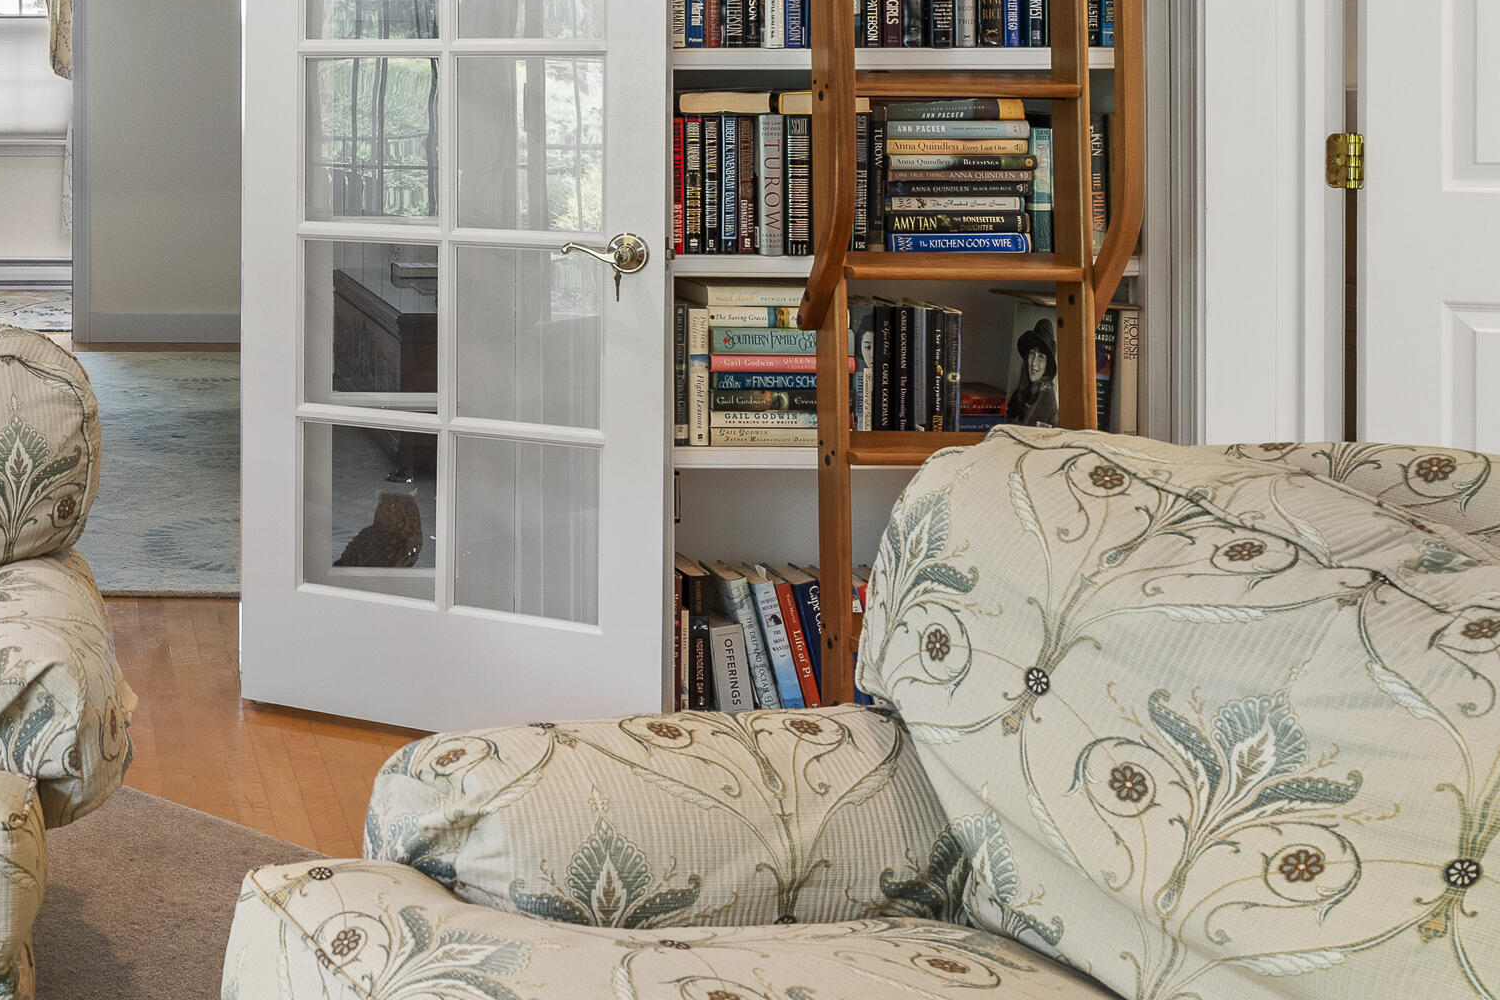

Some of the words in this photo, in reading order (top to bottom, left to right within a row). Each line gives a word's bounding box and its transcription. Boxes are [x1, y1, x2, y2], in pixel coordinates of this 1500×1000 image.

[691, 2, 703, 26] Martini
[886, 0, 899, 24] GIRLS
[764, 139, 780, 230] TUROW
[894, 217, 916, 230] AMY
[917, 217, 937, 230] TAN
[992, 239, 1011, 247] WIFE
[1130, 317, 1138, 360] HOUSE
[696, 375, 704, 397] Flight
[696, 399, 704, 429] Lessons
[792, 630, 805, 651] Life
[696, 638, 704, 680] INDEPENDENCE
[797, 653, 807, 662] of
[724, 639, 741, 705] OFFERINGS
[802, 667, 811, 679] Pi
[696, 682, 704, 693] DAY
